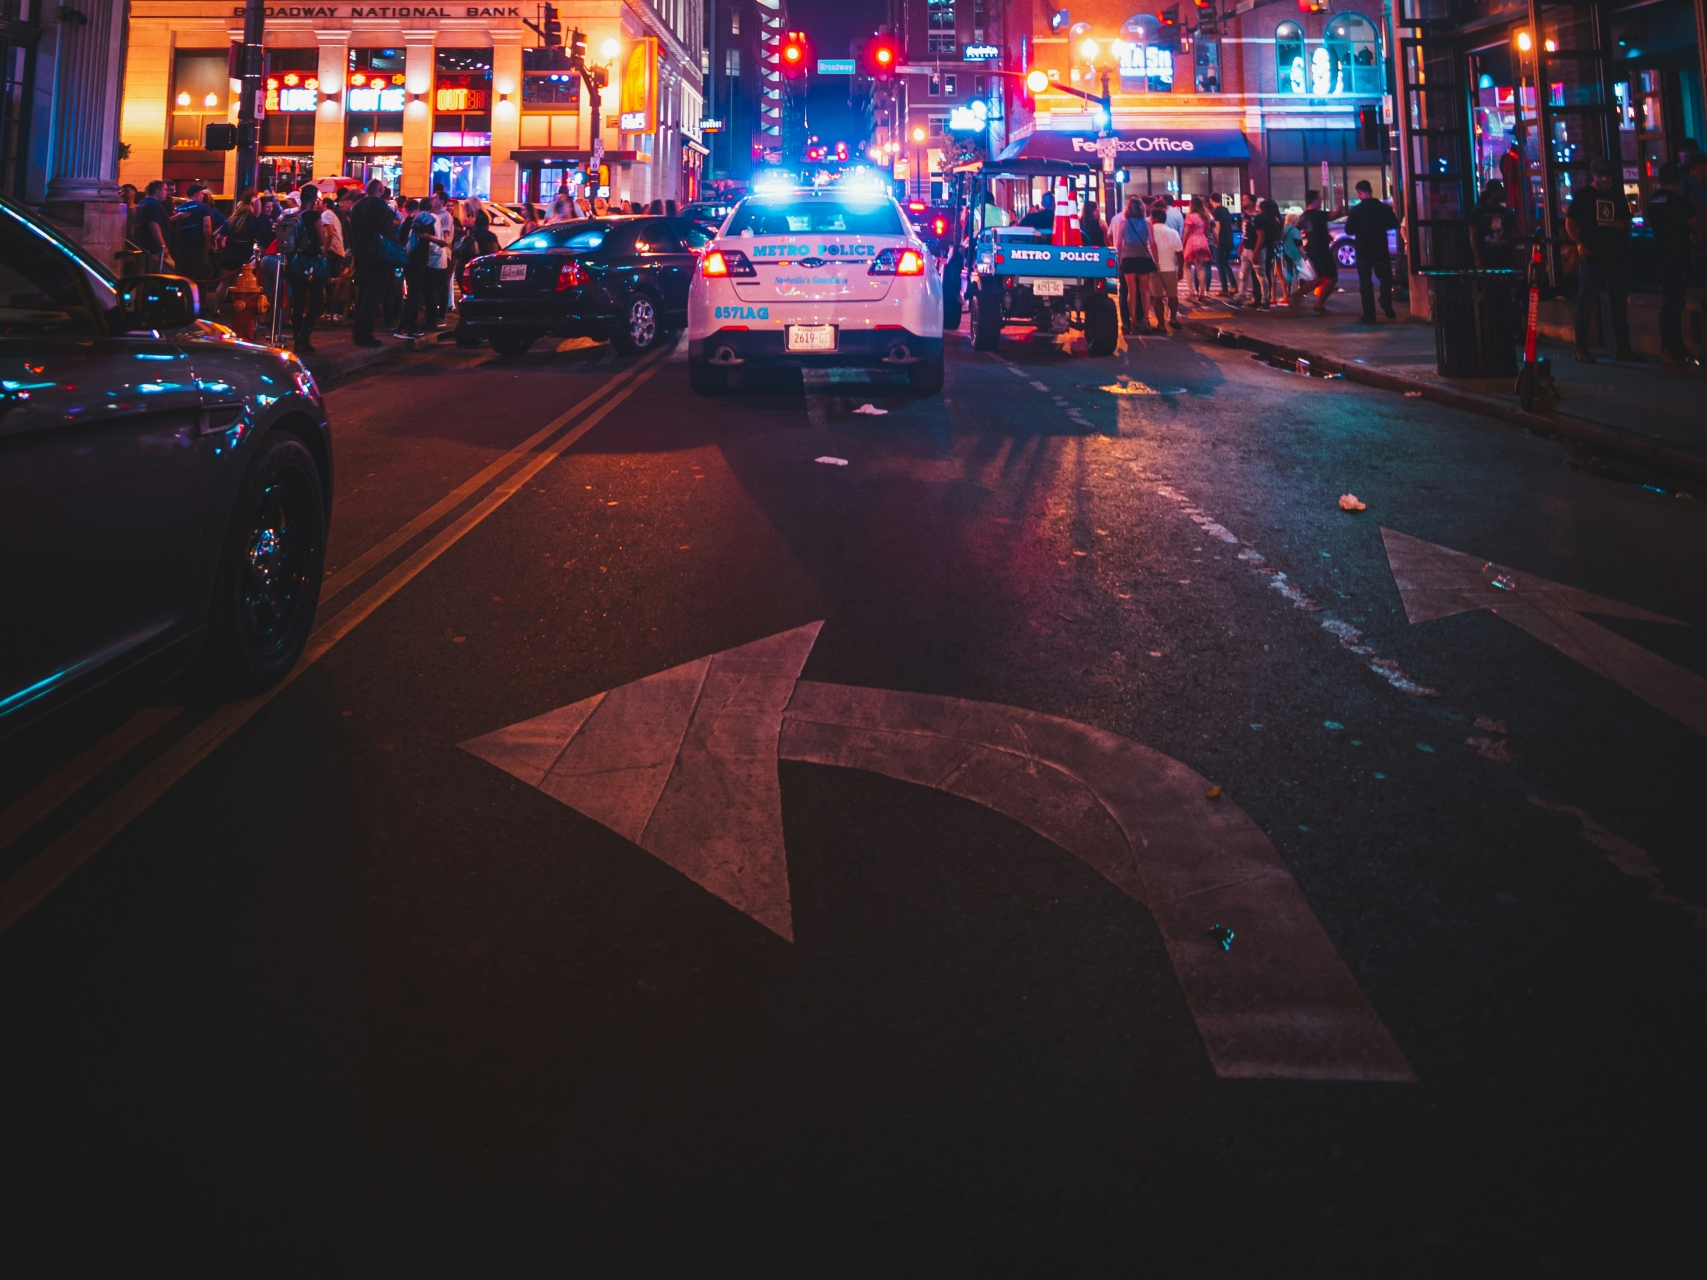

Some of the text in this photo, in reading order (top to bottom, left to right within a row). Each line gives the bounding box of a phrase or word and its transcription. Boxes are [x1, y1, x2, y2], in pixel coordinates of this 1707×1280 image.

[233, 6, 520, 18] BOADWAY NATIONAL BANK
[819, 63, 853, 71] Broadway
[437, 88, 468, 111] OUT
[1071, 136, 1194, 152] FeEx Office
[752, 244, 875, 257] METRO POLICE
[1010, 249, 1100, 262] METRO POLICE
[714, 306, 769, 320] 8571AG
